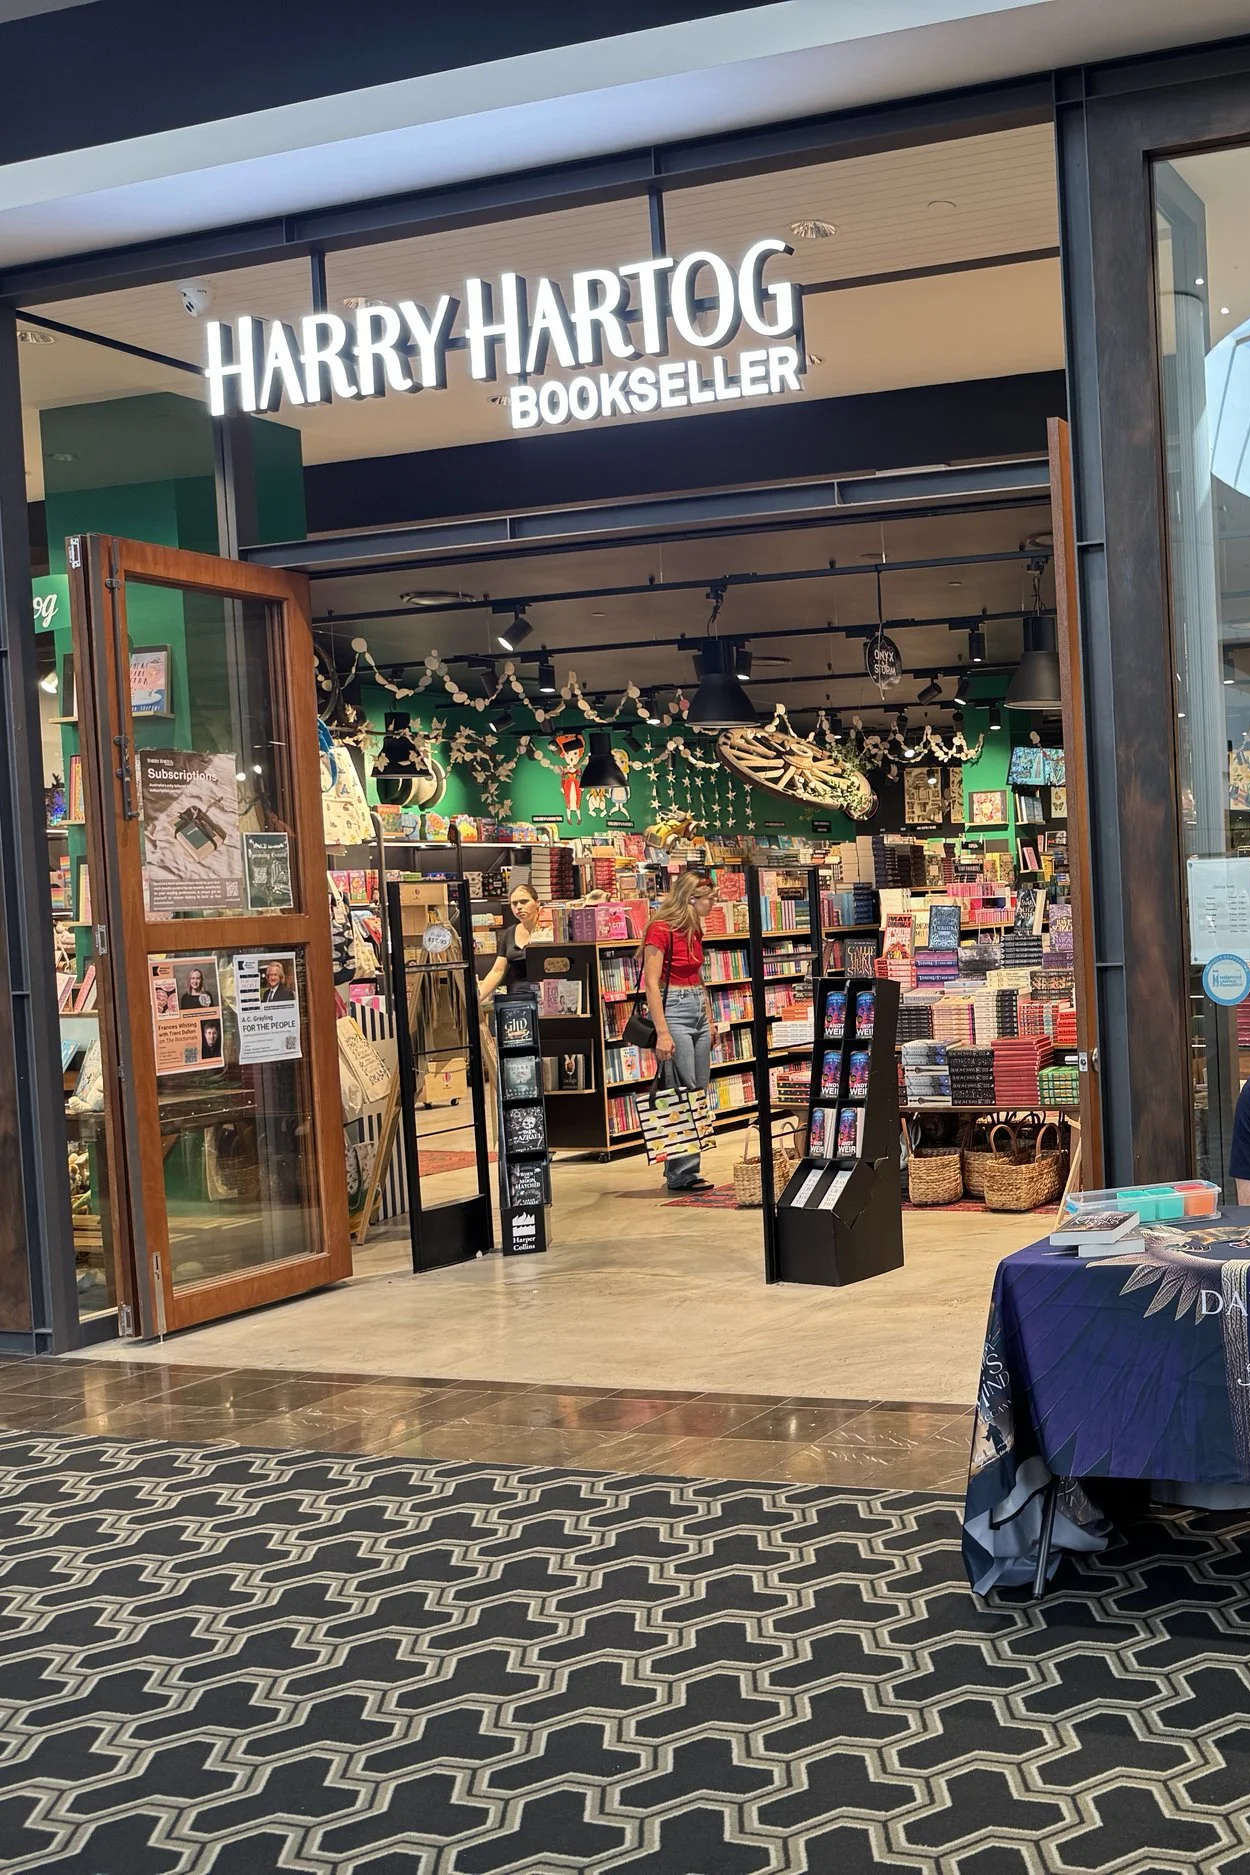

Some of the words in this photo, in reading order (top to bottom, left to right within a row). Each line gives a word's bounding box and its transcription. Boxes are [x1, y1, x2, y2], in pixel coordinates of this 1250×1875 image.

[204, 294, 451, 417] HARRY
[465, 239, 796, 381] HARTOG
[509, 345, 800, 430] BOOKSELLER
[874, 649, 895, 662] ONYX
[874, 664, 897, 676] STORM
[147, 767, 218, 782] Subscriptions
[242, 1024, 256, 1033] FOR
[257, 1023, 270, 1032] THE
[270, 1020, 296, 1030] PEOPLE
[839, 1145, 856, 1153] WEIR
[512, 1236, 536, 1245] Harper
